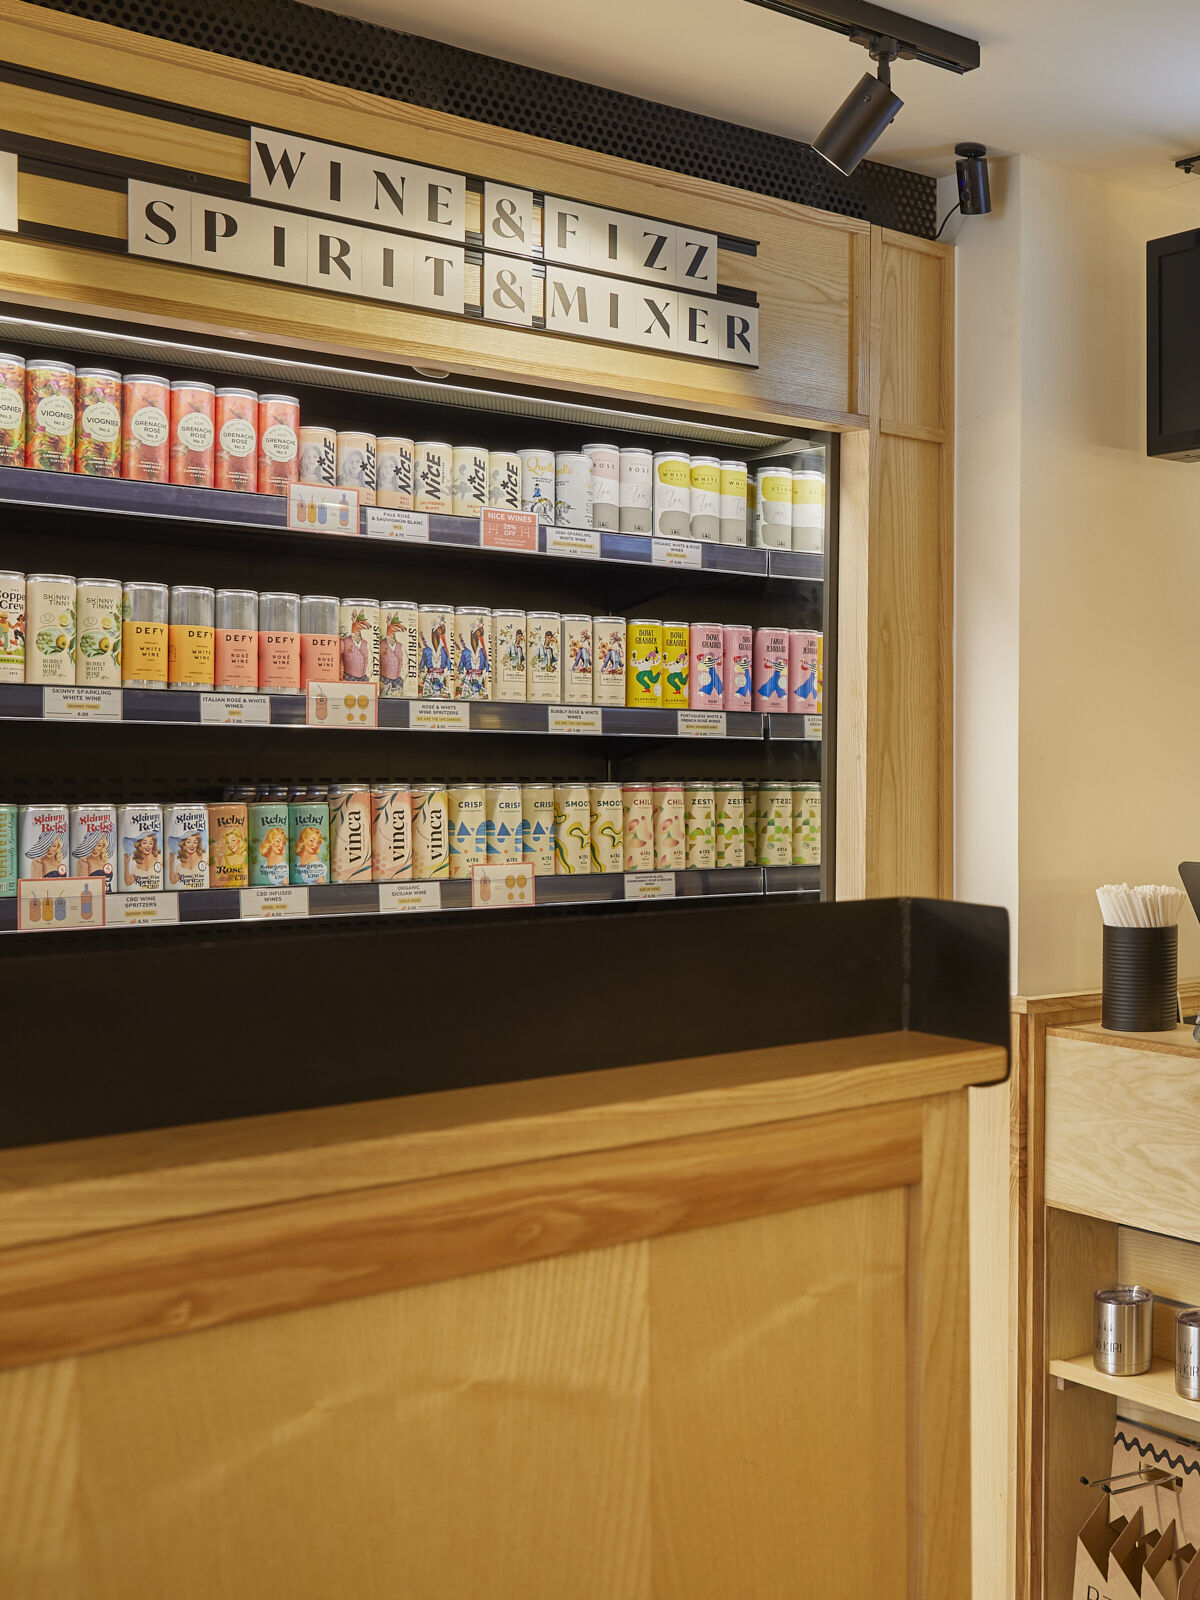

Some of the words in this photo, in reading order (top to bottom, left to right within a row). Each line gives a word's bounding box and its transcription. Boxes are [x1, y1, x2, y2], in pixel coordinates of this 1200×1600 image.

[255, 141, 453, 227] WINE
[492, 198, 525, 240] &
[556, 212, 710, 283] FIZZ
[144, 200, 454, 298] SPIRIT
[492, 269, 525, 311] &
[550, 281, 750, 353] MIXER
[41, 410, 73, 420] VIOGNIER
[87, 417, 119, 427] VIOGNIER
[488, 512, 505, 520] NICE
[507, 514, 532, 523] WINES
[136, 627, 164, 635] DEFY
[188, 630, 213, 638] DEFY
[706, 633, 719, 641] BOWL
[226, 634, 253, 643] DEFY
[408, 628, 416, 678] SPRITZER
[458, 801, 483, 809] CRISP
[33, 813, 65, 826] Skinny
[79, 813, 111, 826] Skinny
[176, 813, 205, 825] Skinny
[217, 815, 245, 827] Rebel
[261, 814, 287, 827] Rebel
[295, 814, 323, 826] Rebel
[345, 810, 362, 863] vinca
[389, 809, 404, 861] vinca
[427, 809, 442, 860] vinca
[1103, 1341, 1122, 1354] KIRI
